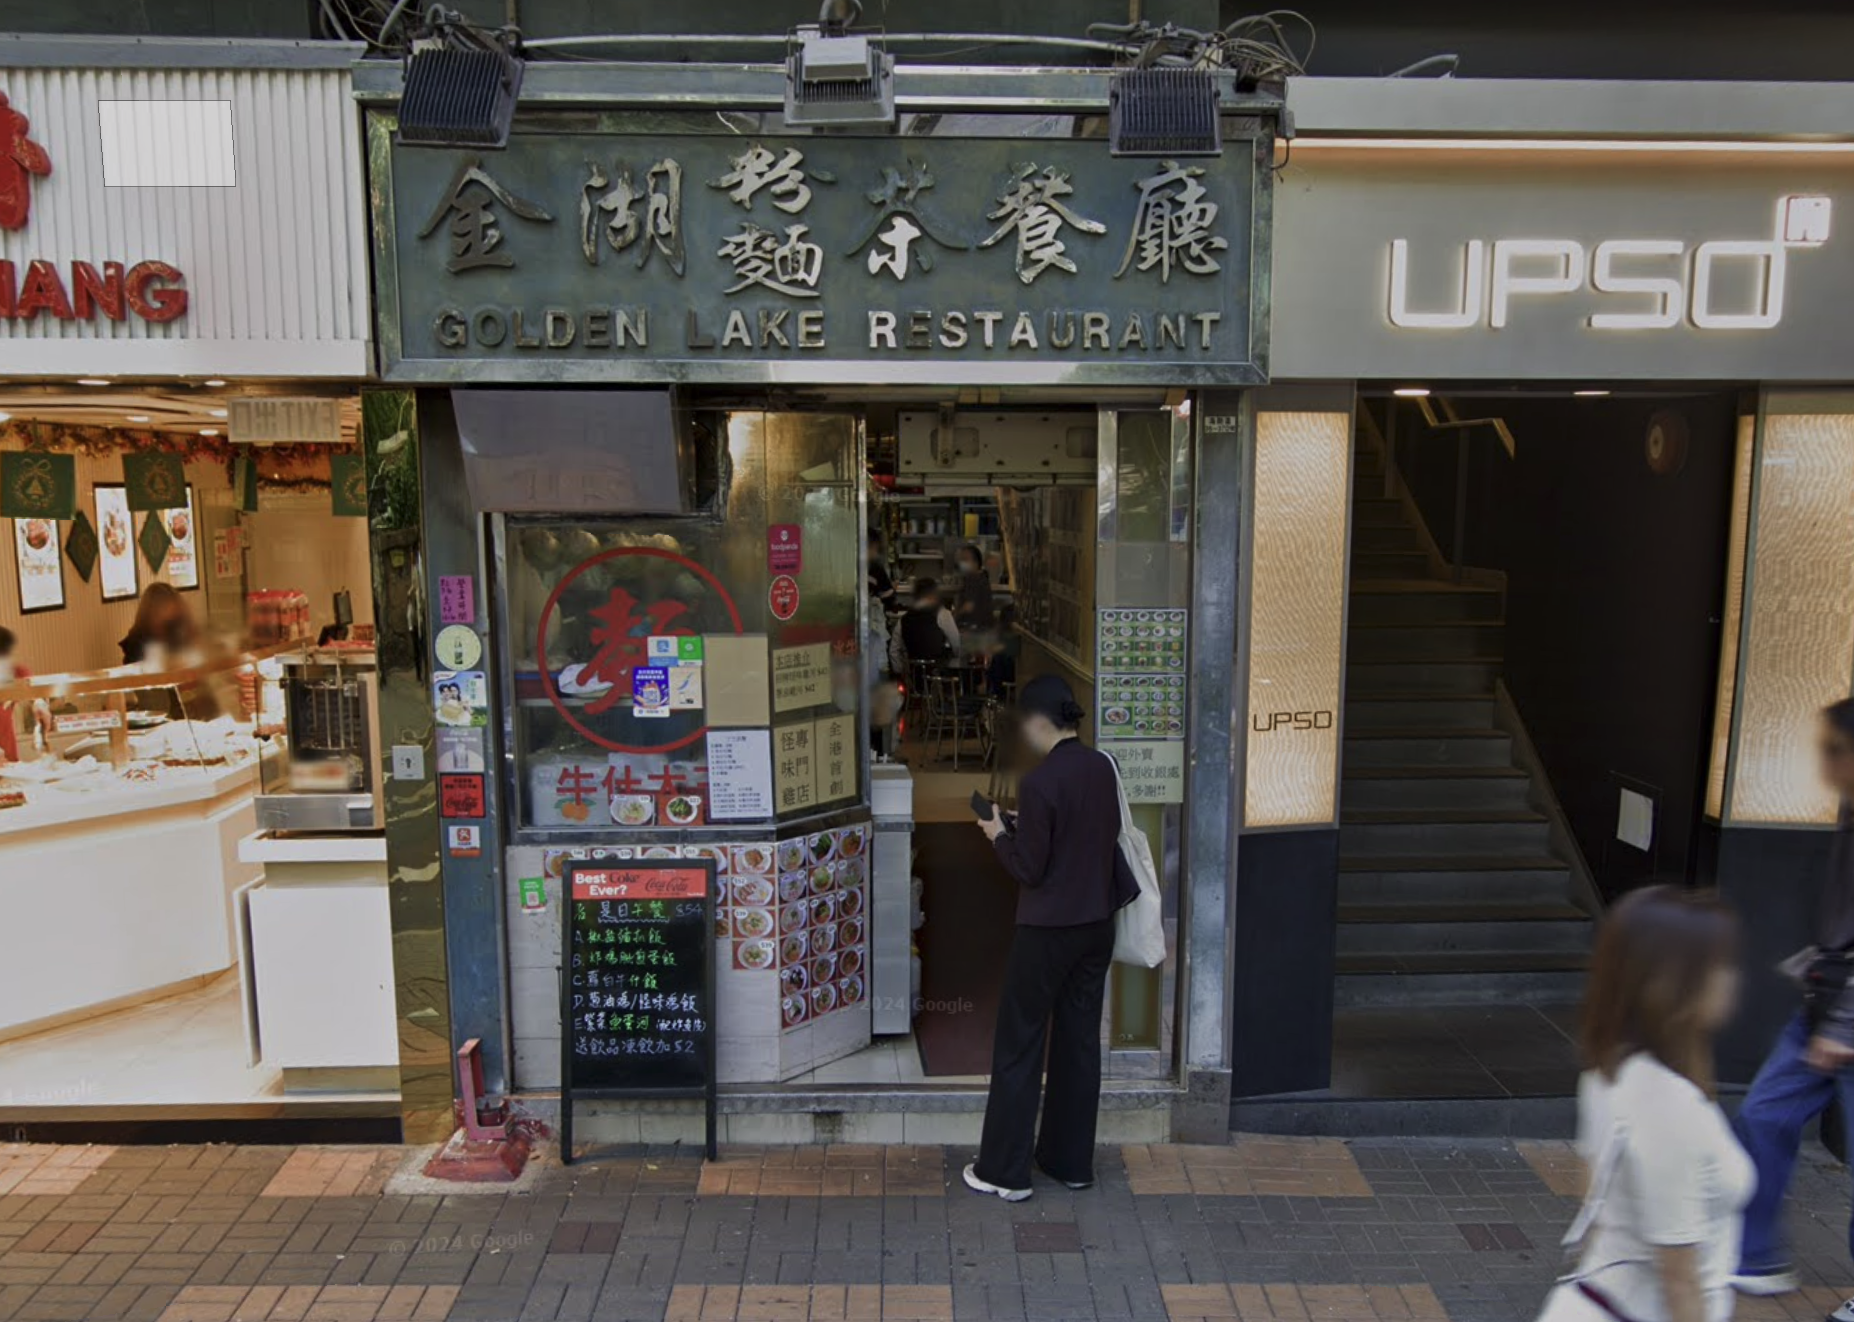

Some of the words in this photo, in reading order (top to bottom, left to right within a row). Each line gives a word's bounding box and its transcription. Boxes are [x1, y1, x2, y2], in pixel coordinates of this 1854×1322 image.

[1389, 196, 1830, 328] UPSO
[434, 308, 648, 348] GOLDEN
[688, 309, 826, 348] LAKE
[868, 310, 1222, 349] RESTAURANT
[1253, 710, 1332, 732] UPSO
[575, 873, 607, 884] Best
[609, 873, 640, 884] Coke
[589, 885, 628, 896] Ever?
[601, 901, 666, 919] 是日午餐
